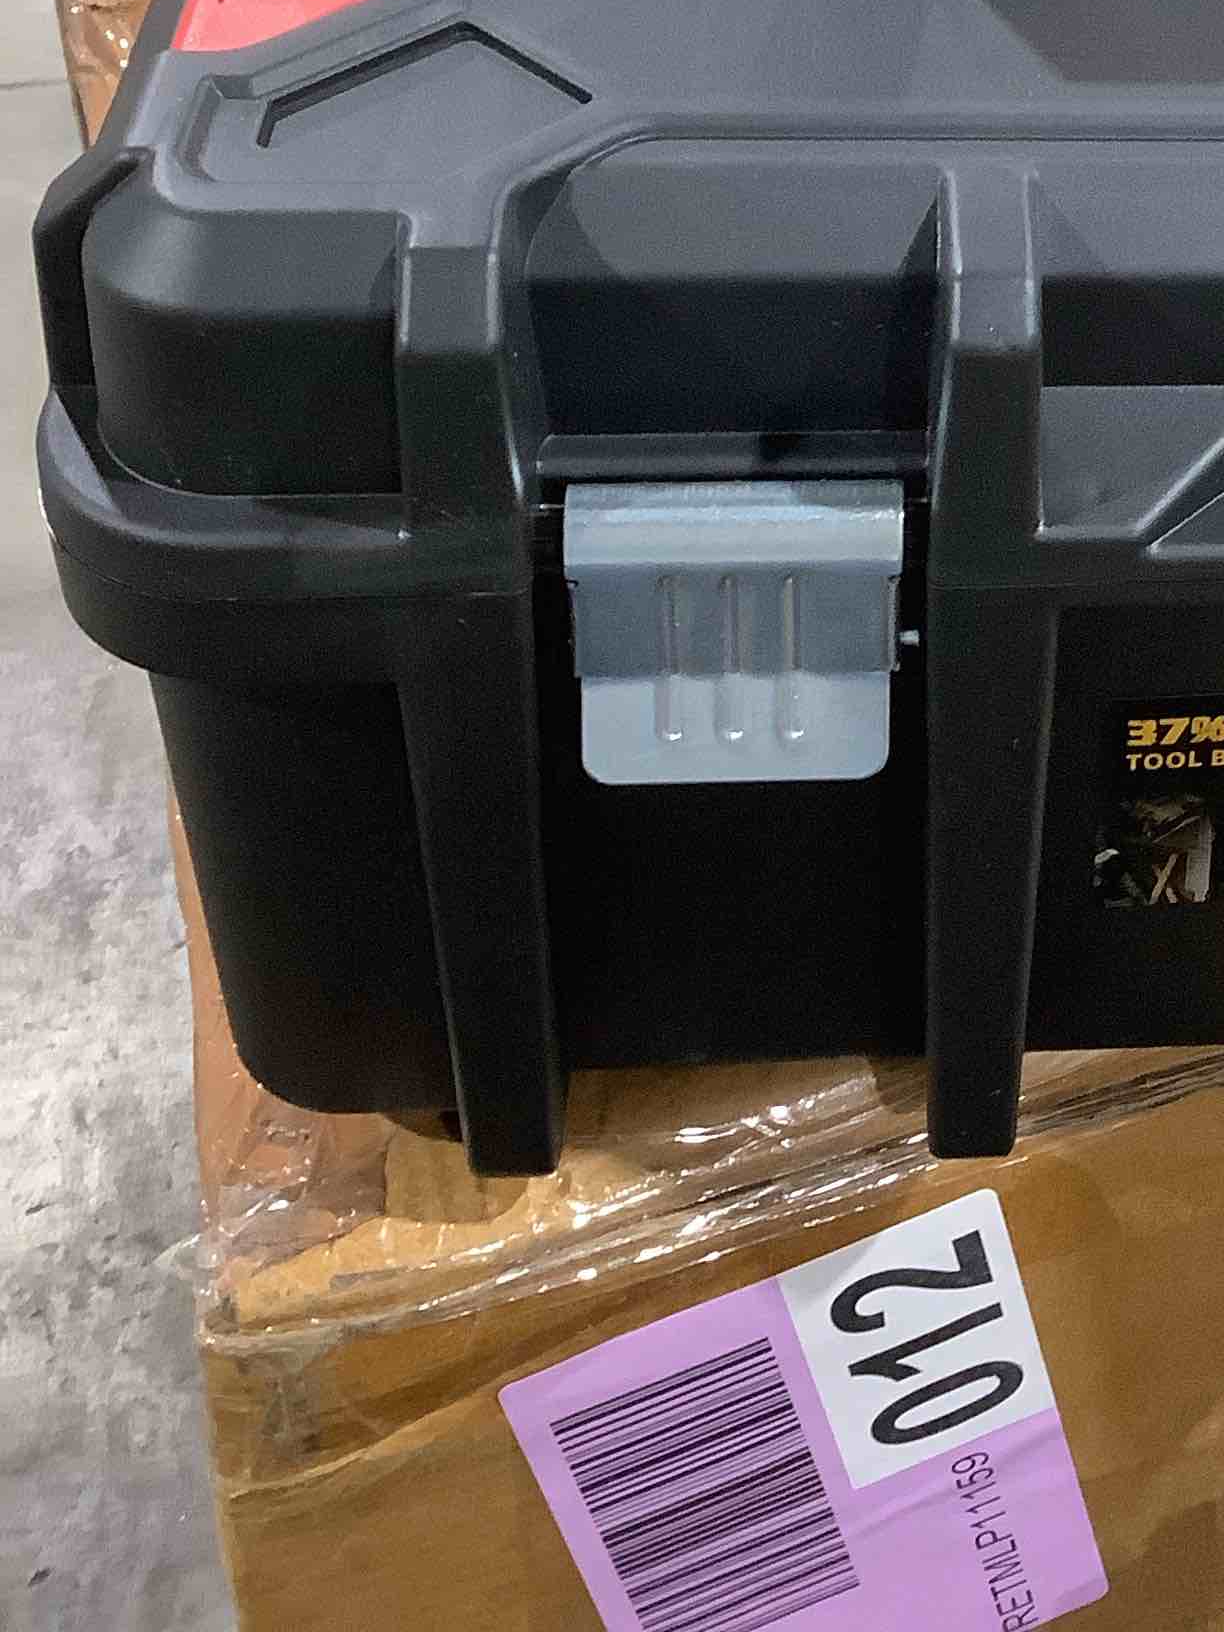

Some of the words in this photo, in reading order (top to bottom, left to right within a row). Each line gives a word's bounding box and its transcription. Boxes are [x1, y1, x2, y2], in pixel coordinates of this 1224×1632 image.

[1126, 750, 1201, 772] TOOL
[830, 1229, 1024, 1447] 012
[950, 1451, 1040, 1632] RETMLP11159
